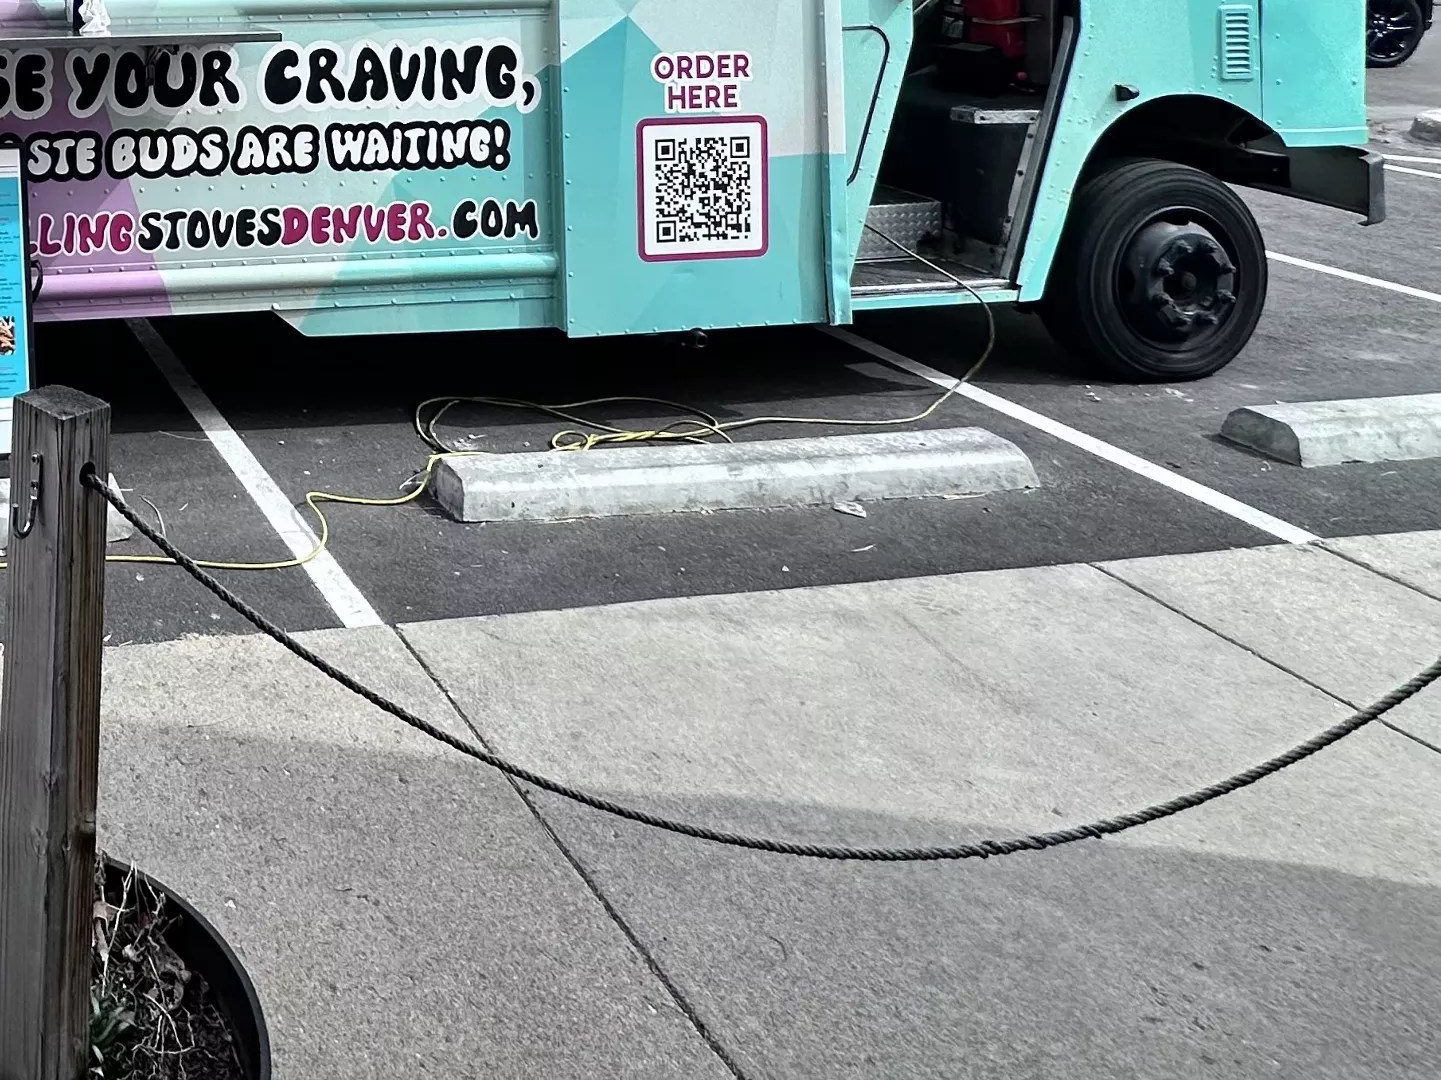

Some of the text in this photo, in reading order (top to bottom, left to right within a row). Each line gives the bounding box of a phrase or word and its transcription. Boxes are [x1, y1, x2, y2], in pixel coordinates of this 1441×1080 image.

[71, 46, 241, 112] YOUR
[264, 46, 537, 106] CRAVING,
[654, 54, 750, 80] ORDER
[667, 84, 738, 110] HERE
[111, 130, 224, 174] BUDS
[238, 129, 315, 169] ARE
[327, 124, 508, 168] WAITING!
[29, 200, 538, 256] LINGSTOVESDENVER.COM
